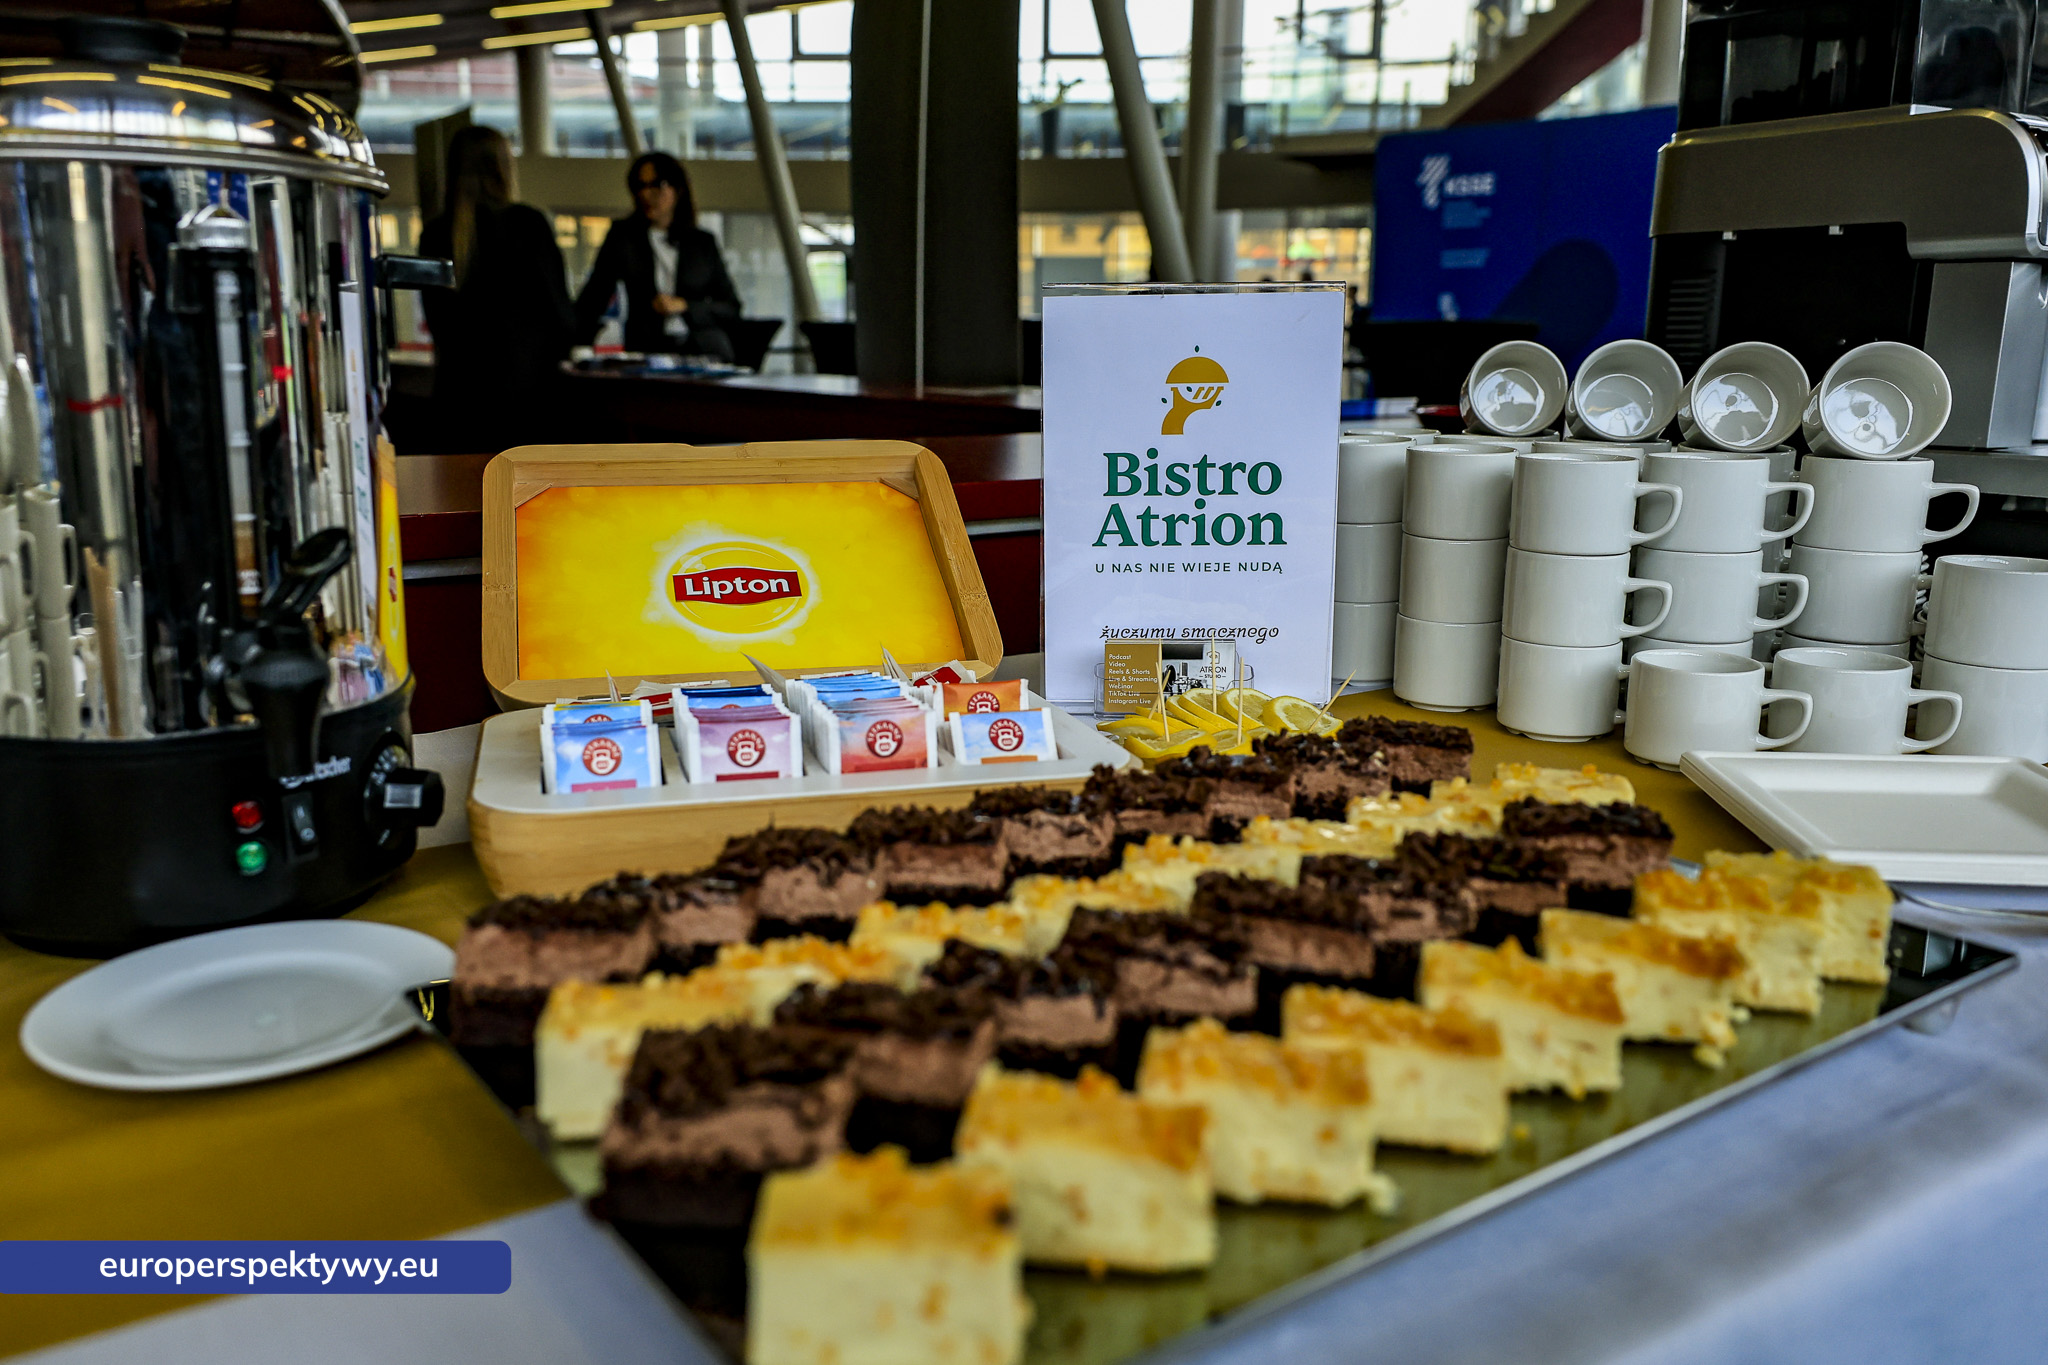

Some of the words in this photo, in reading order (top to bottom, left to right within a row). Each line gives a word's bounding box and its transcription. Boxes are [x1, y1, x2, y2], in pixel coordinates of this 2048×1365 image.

[1103, 447, 1283, 496] Bistro
[1092, 498, 1287, 547] Atrion
[1095, 563, 1105, 573] U
[1112, 562, 1142, 573] NAS
[1150, 562, 1176, 573] NIE
[1182, 562, 1230, 573] WIEJE
[1239, 562, 1283, 575] NUDĄ
[684, 576, 790, 599] Lipton
[1181, 626, 1279, 645] smacznego
